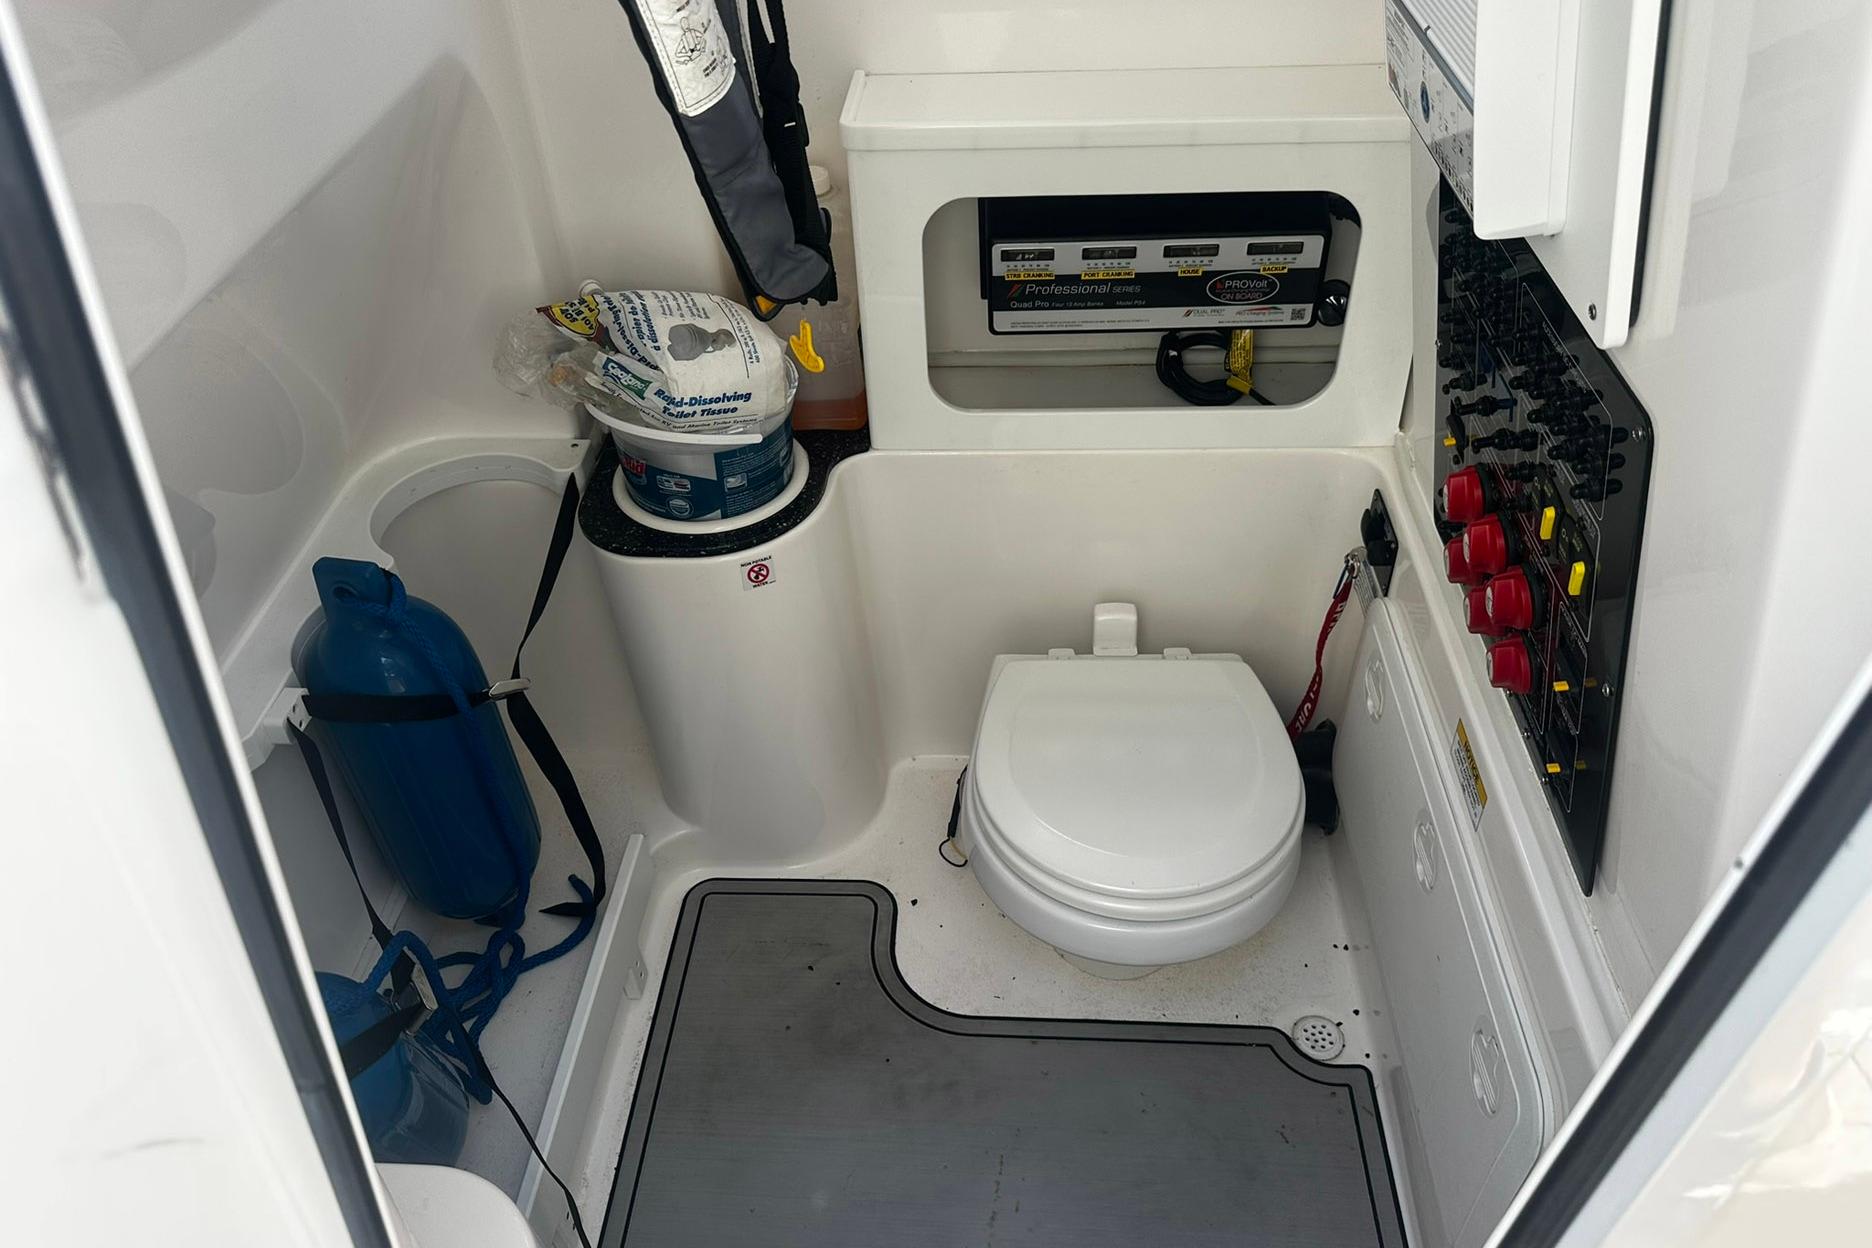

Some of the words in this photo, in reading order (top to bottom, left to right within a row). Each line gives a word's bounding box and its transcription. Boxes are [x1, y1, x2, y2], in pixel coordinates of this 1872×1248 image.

[1025, 283, 1111, 295] Professional
[1112, 285, 1141, 294] SERIES
[1235, 292, 1263, 300] BOARD
[1010, 301, 1033, 309] Quad
[1034, 300, 1050, 308] Pro
[662, 406, 697, 419] Toilet
[700, 406, 738, 417] Tissue
